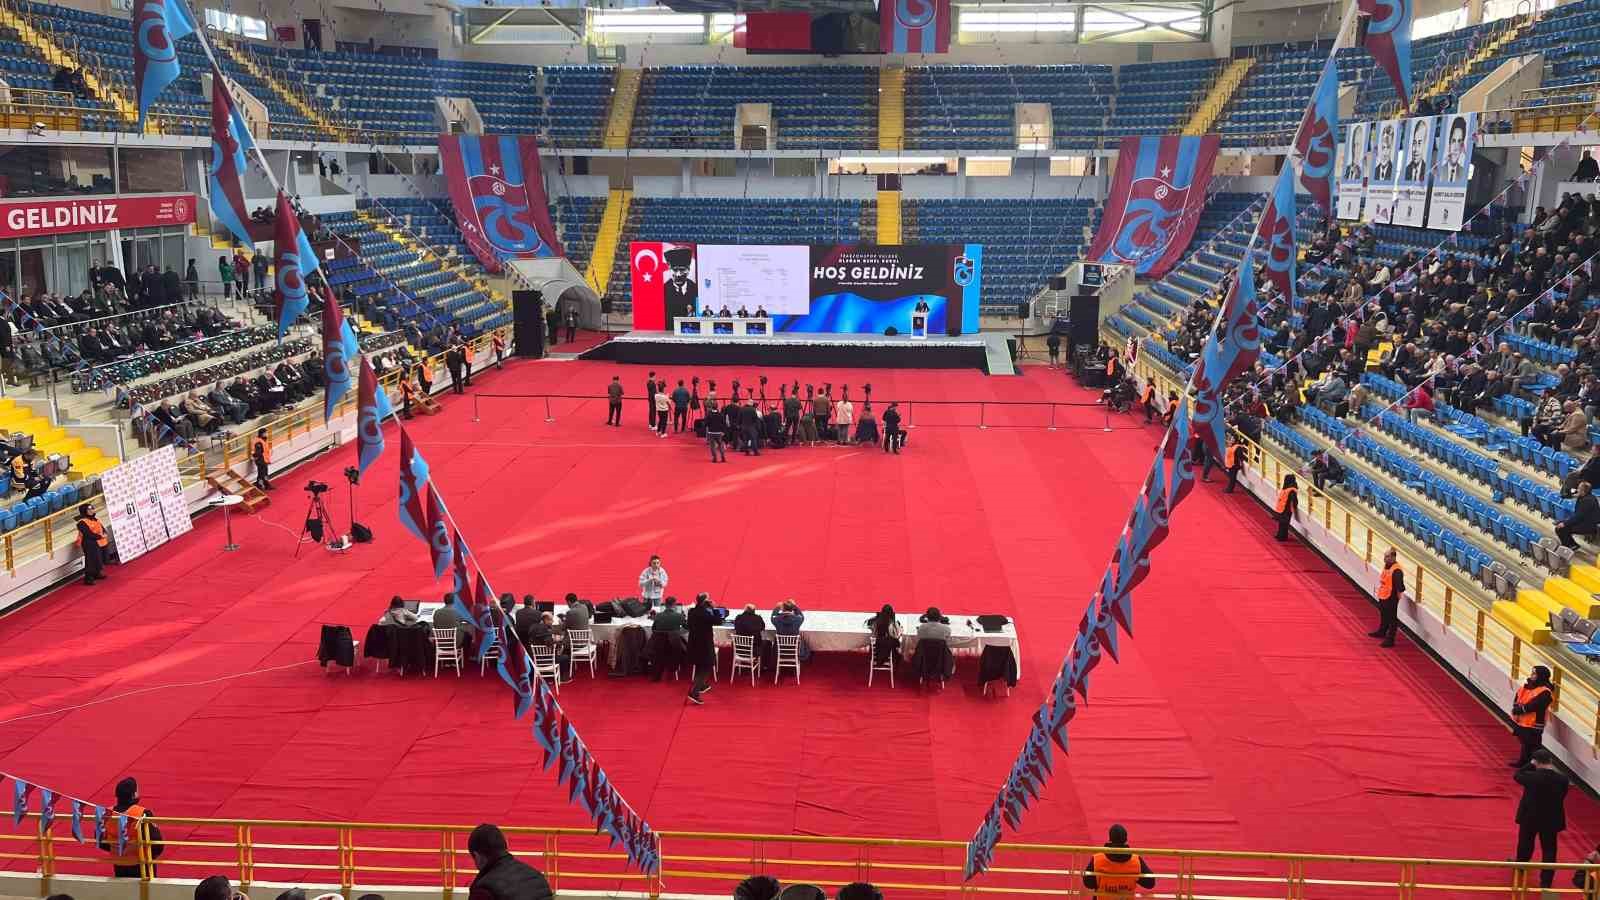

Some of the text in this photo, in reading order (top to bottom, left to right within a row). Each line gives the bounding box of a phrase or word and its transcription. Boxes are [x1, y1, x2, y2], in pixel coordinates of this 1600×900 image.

[7, 200, 119, 230] GELDİNİZ
[813, 263, 924, 280] HOŞ GELDİNİZ
[173, 481, 182, 493] 61
